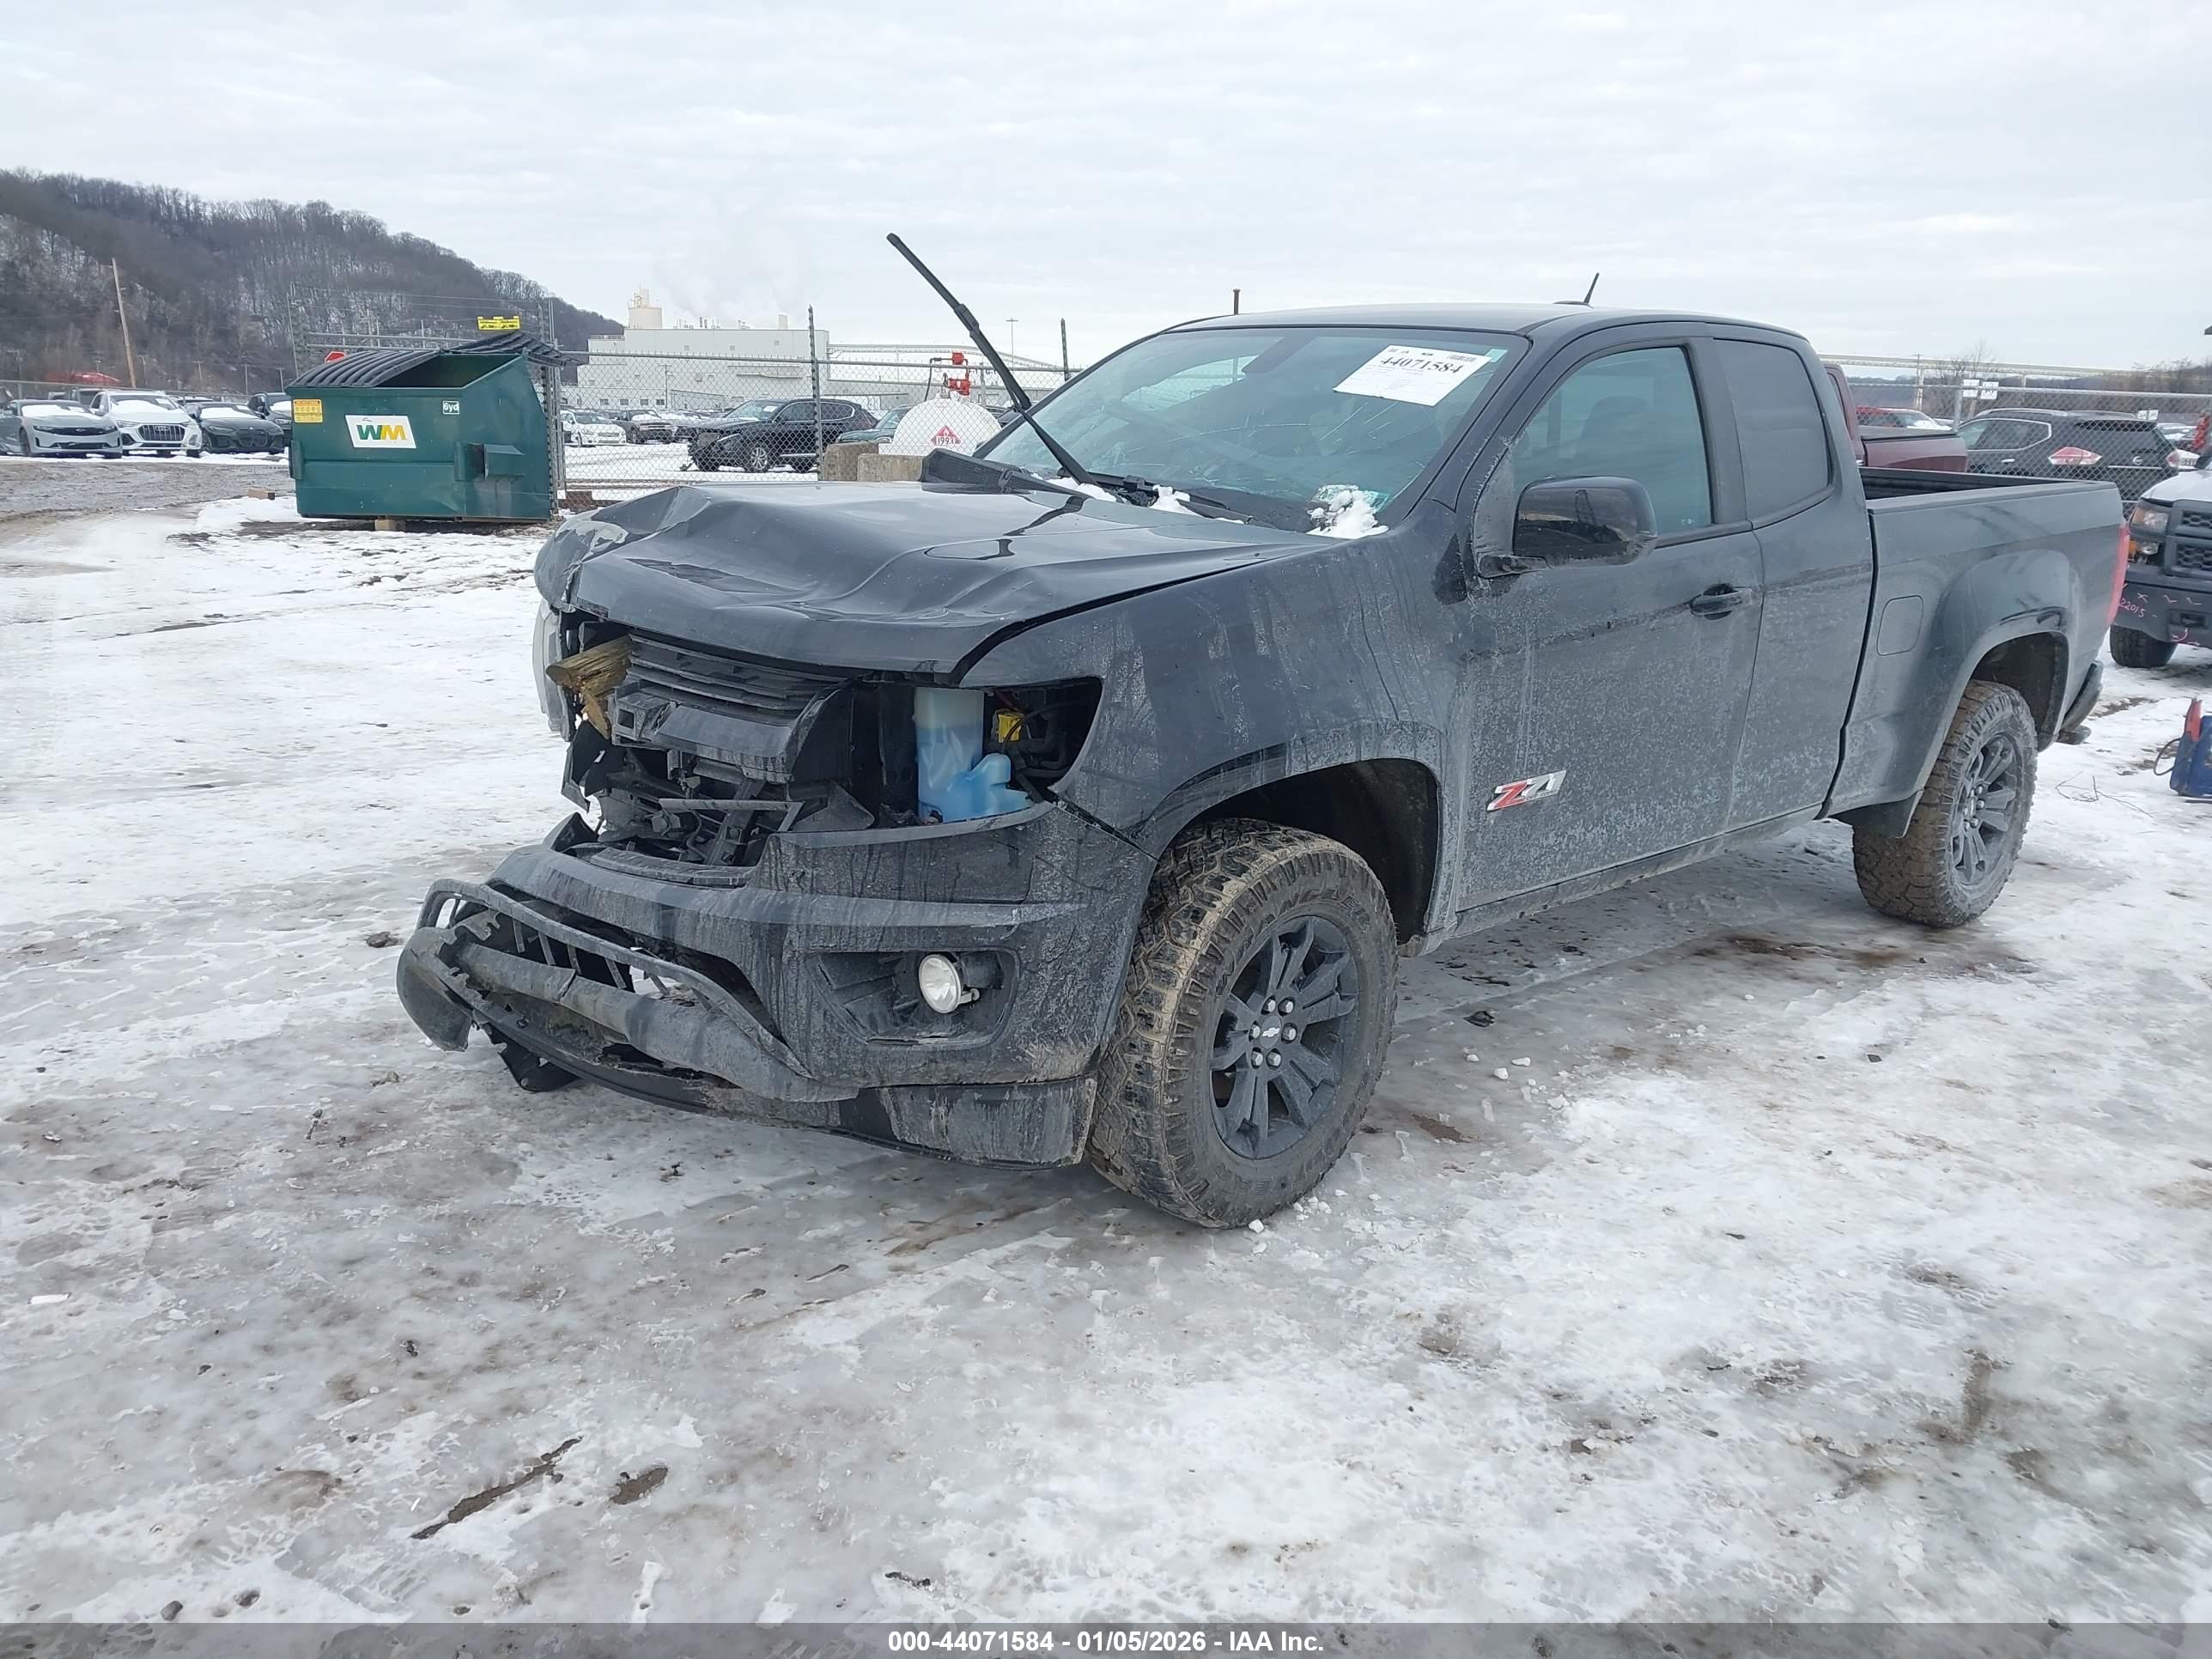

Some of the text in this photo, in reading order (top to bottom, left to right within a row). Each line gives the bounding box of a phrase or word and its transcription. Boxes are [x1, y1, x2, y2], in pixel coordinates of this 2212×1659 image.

[1381, 357, 1463, 373] 44071584
[356, 425, 406, 440] WM
[1486, 770, 1566, 811] Z71
